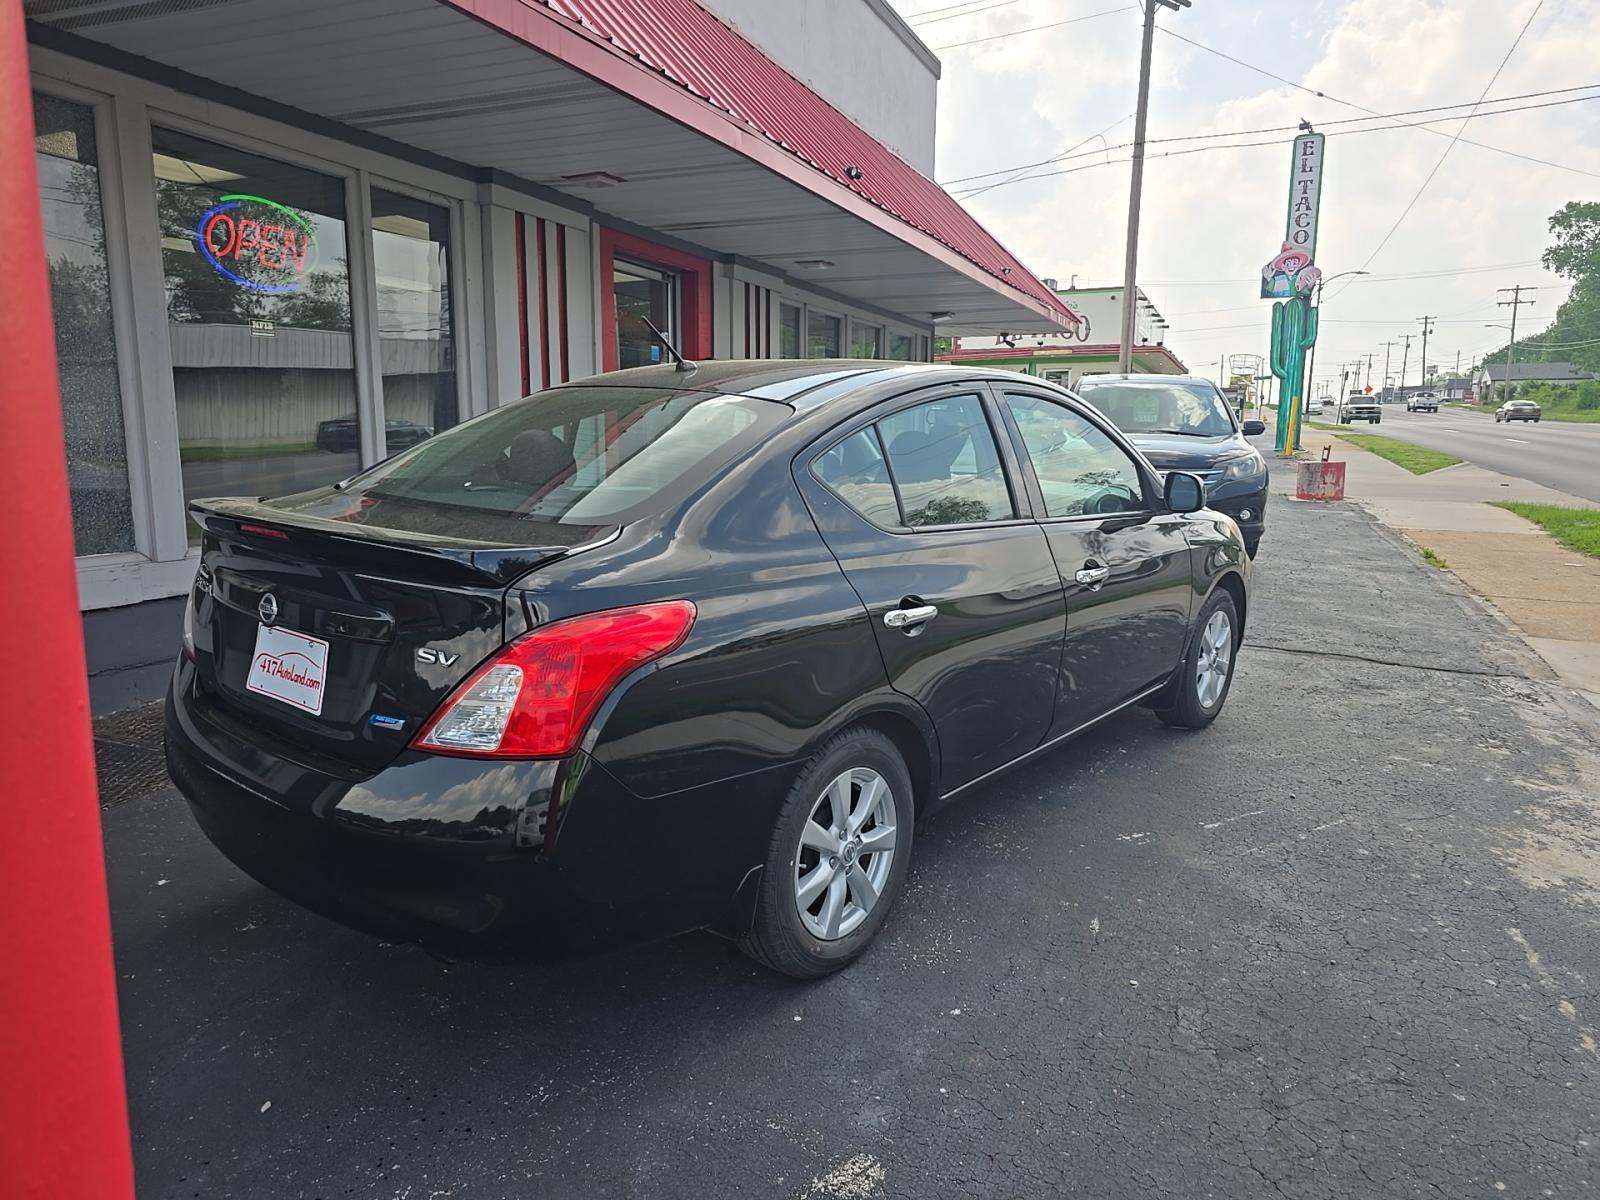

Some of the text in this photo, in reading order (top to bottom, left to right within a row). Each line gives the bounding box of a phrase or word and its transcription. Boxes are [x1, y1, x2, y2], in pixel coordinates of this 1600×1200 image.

[1293, 140, 1315, 245] EL TACO
[206, 213, 309, 273] OPEN
[417, 647, 460, 668] SV
